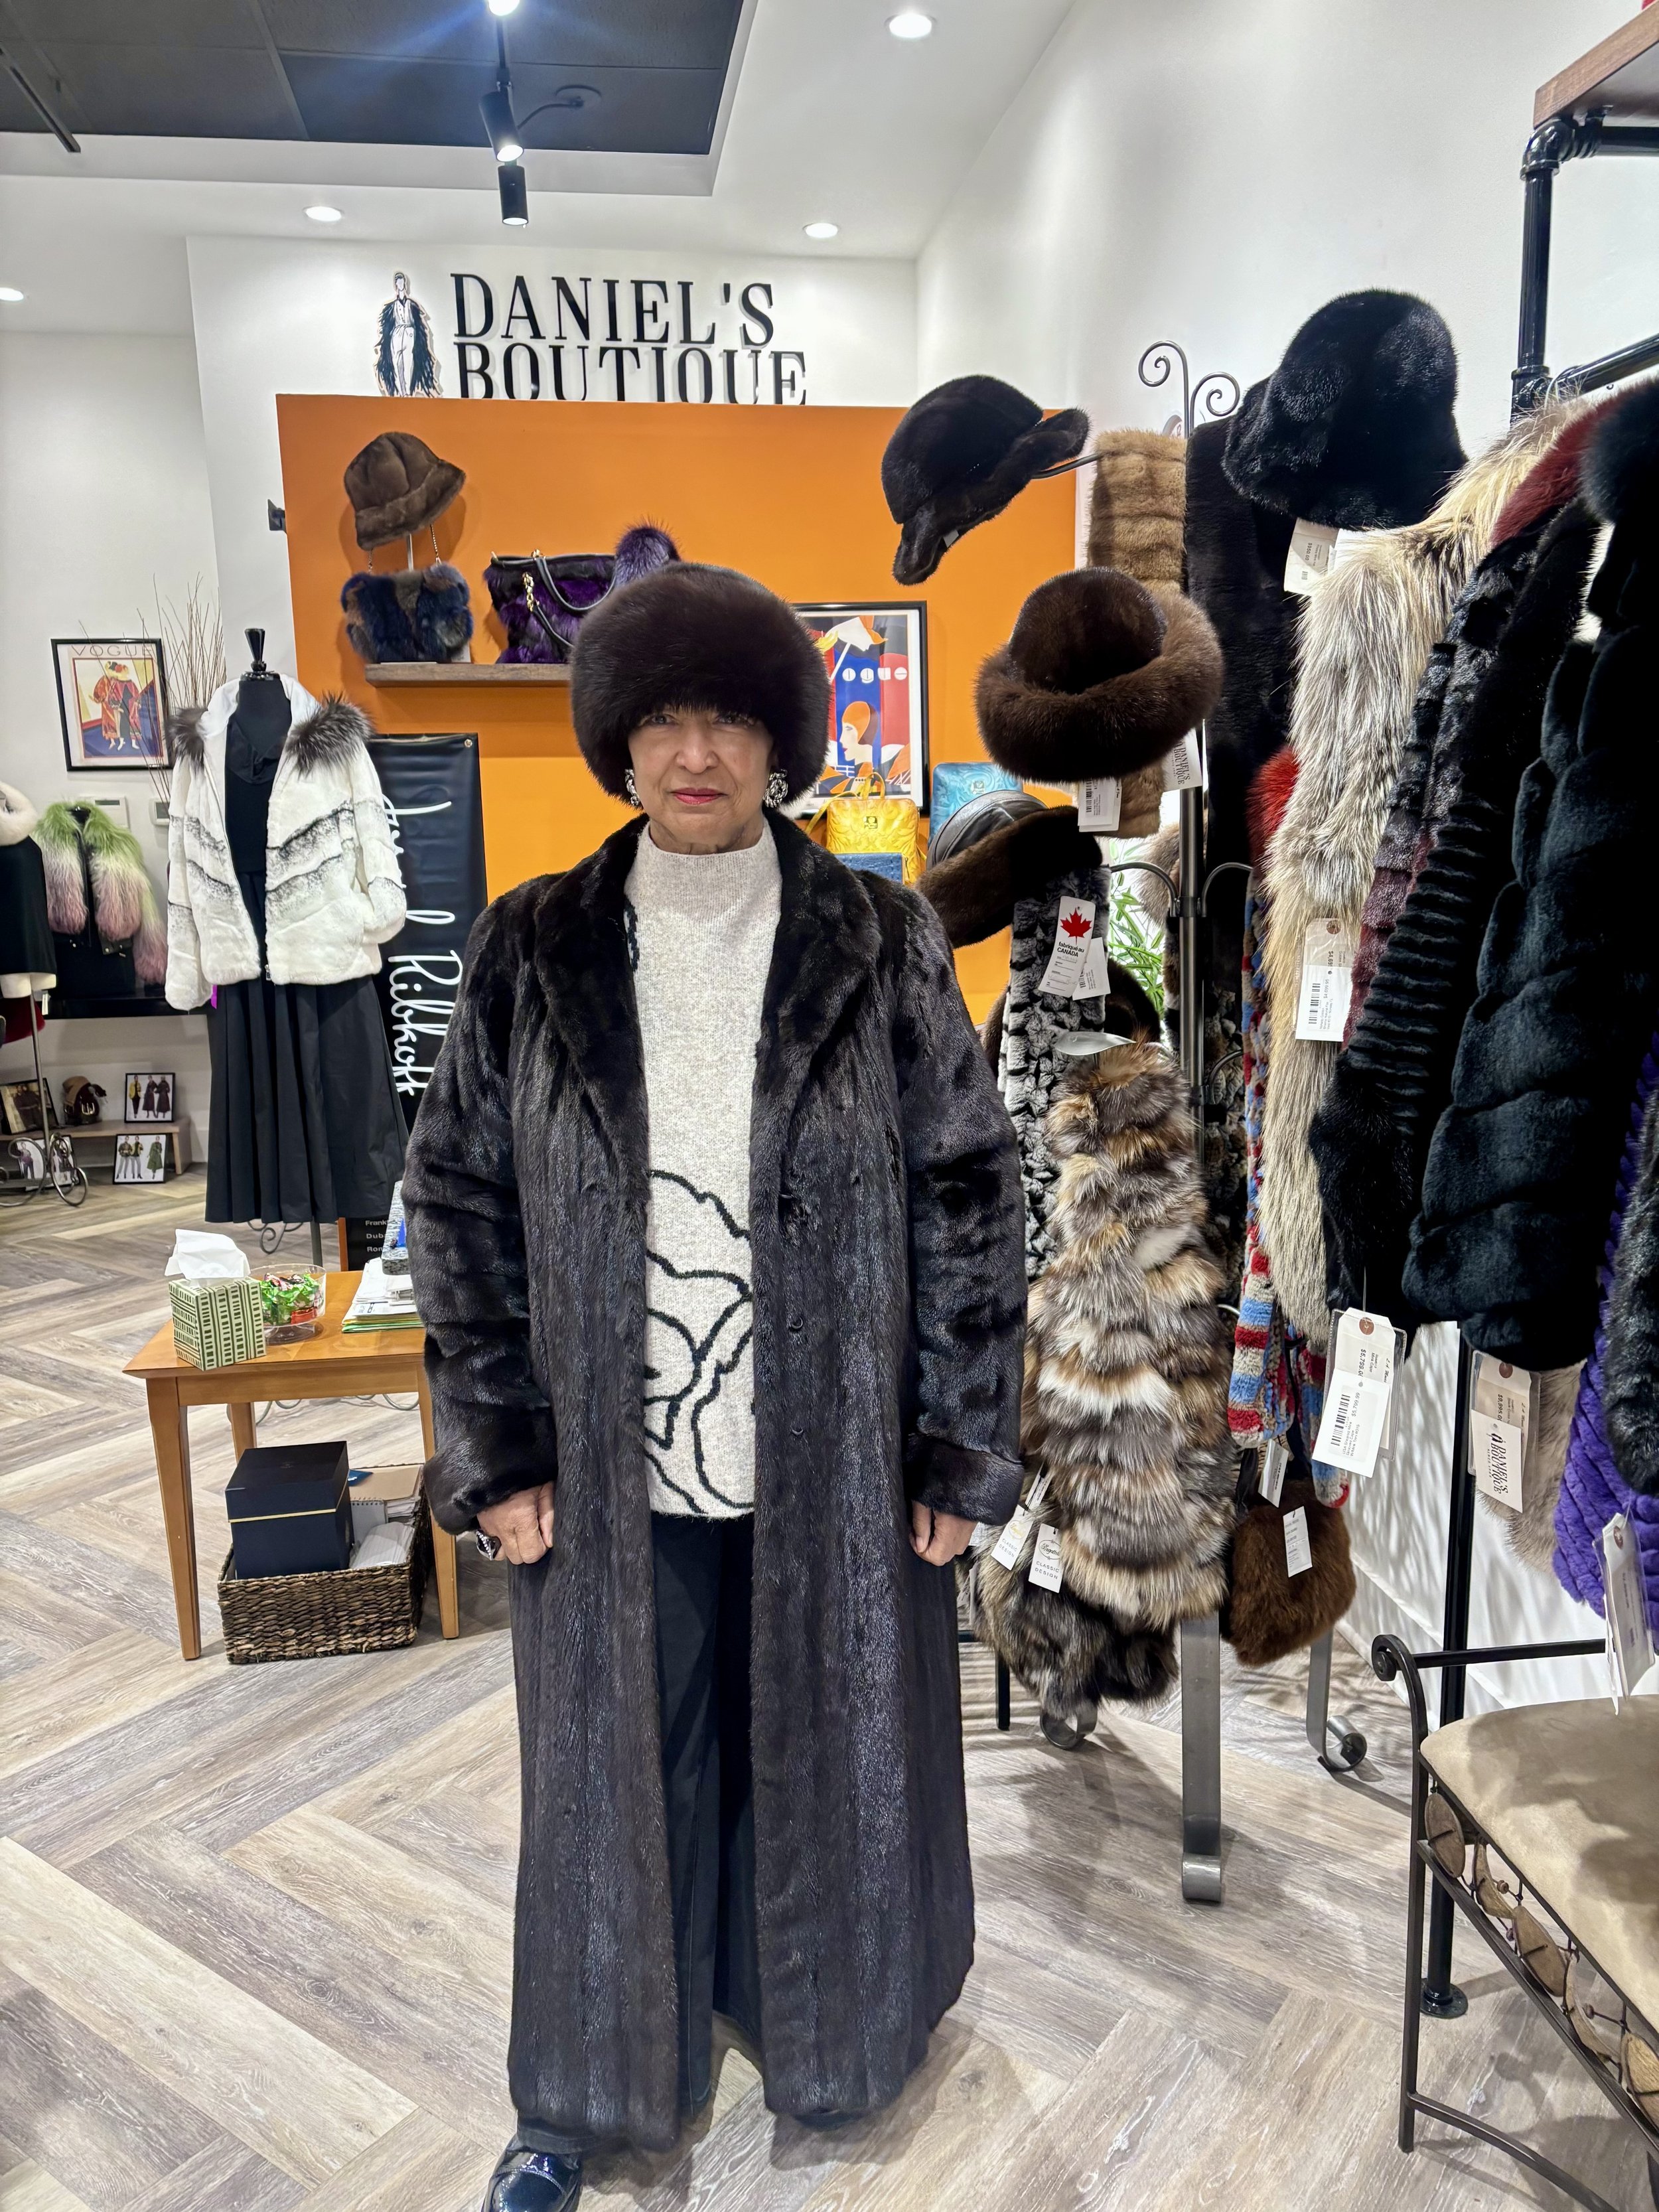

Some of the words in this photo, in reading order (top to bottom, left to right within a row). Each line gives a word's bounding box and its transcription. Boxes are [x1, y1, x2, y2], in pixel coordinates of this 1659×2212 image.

[451, 273, 774, 347] DANIEL'S
[453, 341, 806, 406] BOUTIQUE
[71, 644, 151, 656] VOGUE
[841, 666, 908, 684] ogue
[1056, 947, 1078, 957] CANADA
[1058, 941, 1078, 951] fabriqué
[1490, 1442, 1502, 1494] BOUTIQUE
[1496, 1445, 1508, 1494] DANIEL'S
[999, 1544, 1015, 1558] DESIGN
[1002, 1538, 1018, 1552] CLASSIC
[1035, 1567, 1058, 1580] DESIGN
[1036, 1560, 1060, 1573] CLASSIC
